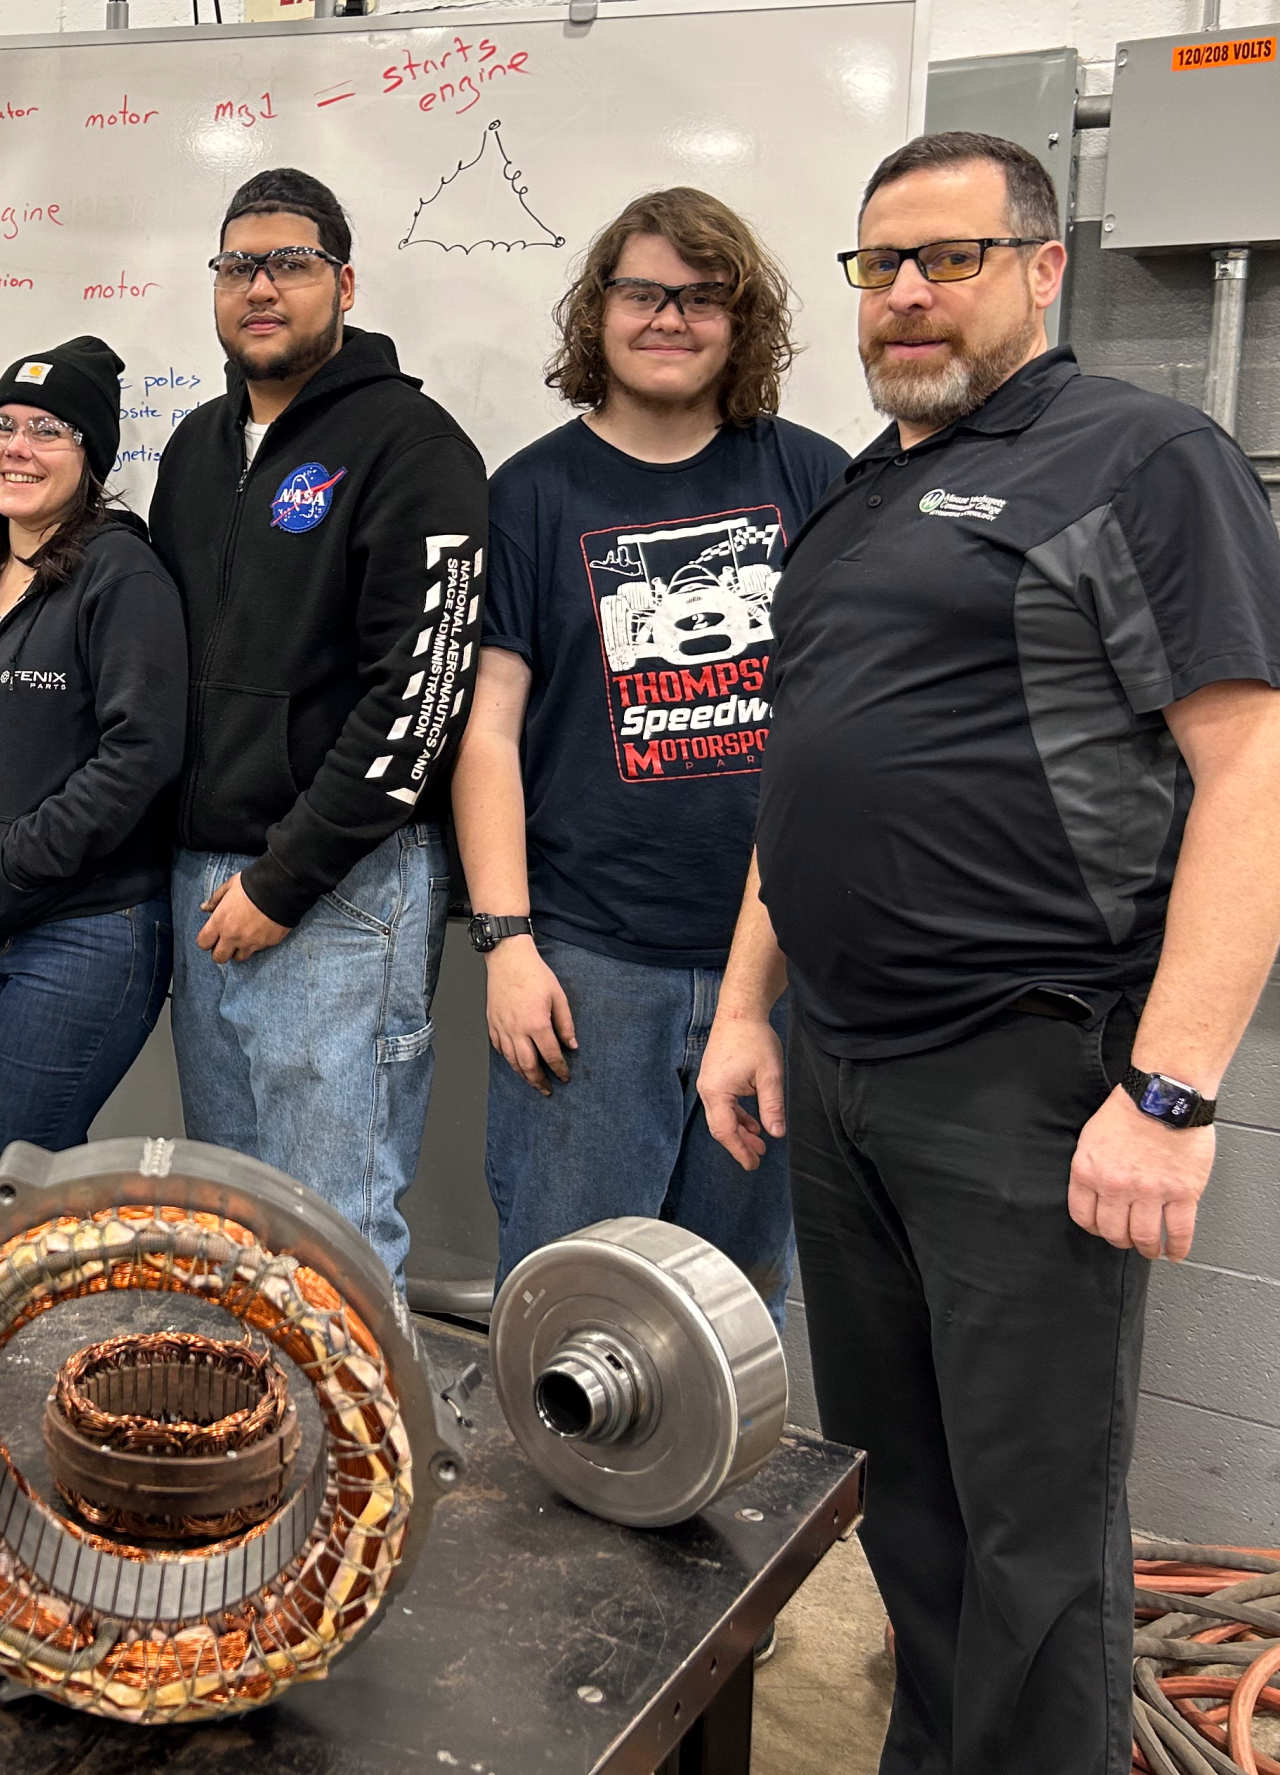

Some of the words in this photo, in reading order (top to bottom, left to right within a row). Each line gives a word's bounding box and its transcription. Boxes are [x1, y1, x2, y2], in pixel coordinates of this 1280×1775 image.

[1178, 45, 1229, 66] 120/208
[1234, 40, 1272, 60] VOLTS
[85, 94, 159, 129] motor
[383, 37, 497, 93] starts
[419, 52, 531, 114] engine
[83, 270, 163, 300] motor
[144, 367, 202, 397] poles
[119, 402, 162, 420] osite
[279, 487, 325, 507] NASA
[444, 557, 458, 610] SPACE
[451, 558, 471, 637] NATIONAL
[30, 682, 67, 691] PARTS
[413, 611, 451, 738] ADMINISTRATION
[426, 639, 460, 748] AERONAUTICS
[612, 655, 770, 707] THOMPS
[620, 694, 773, 740] Speedw
[411, 748, 432, 780] AND
[623, 728, 770, 777] MOTORSPO
[685, 755, 756, 770] PAR
